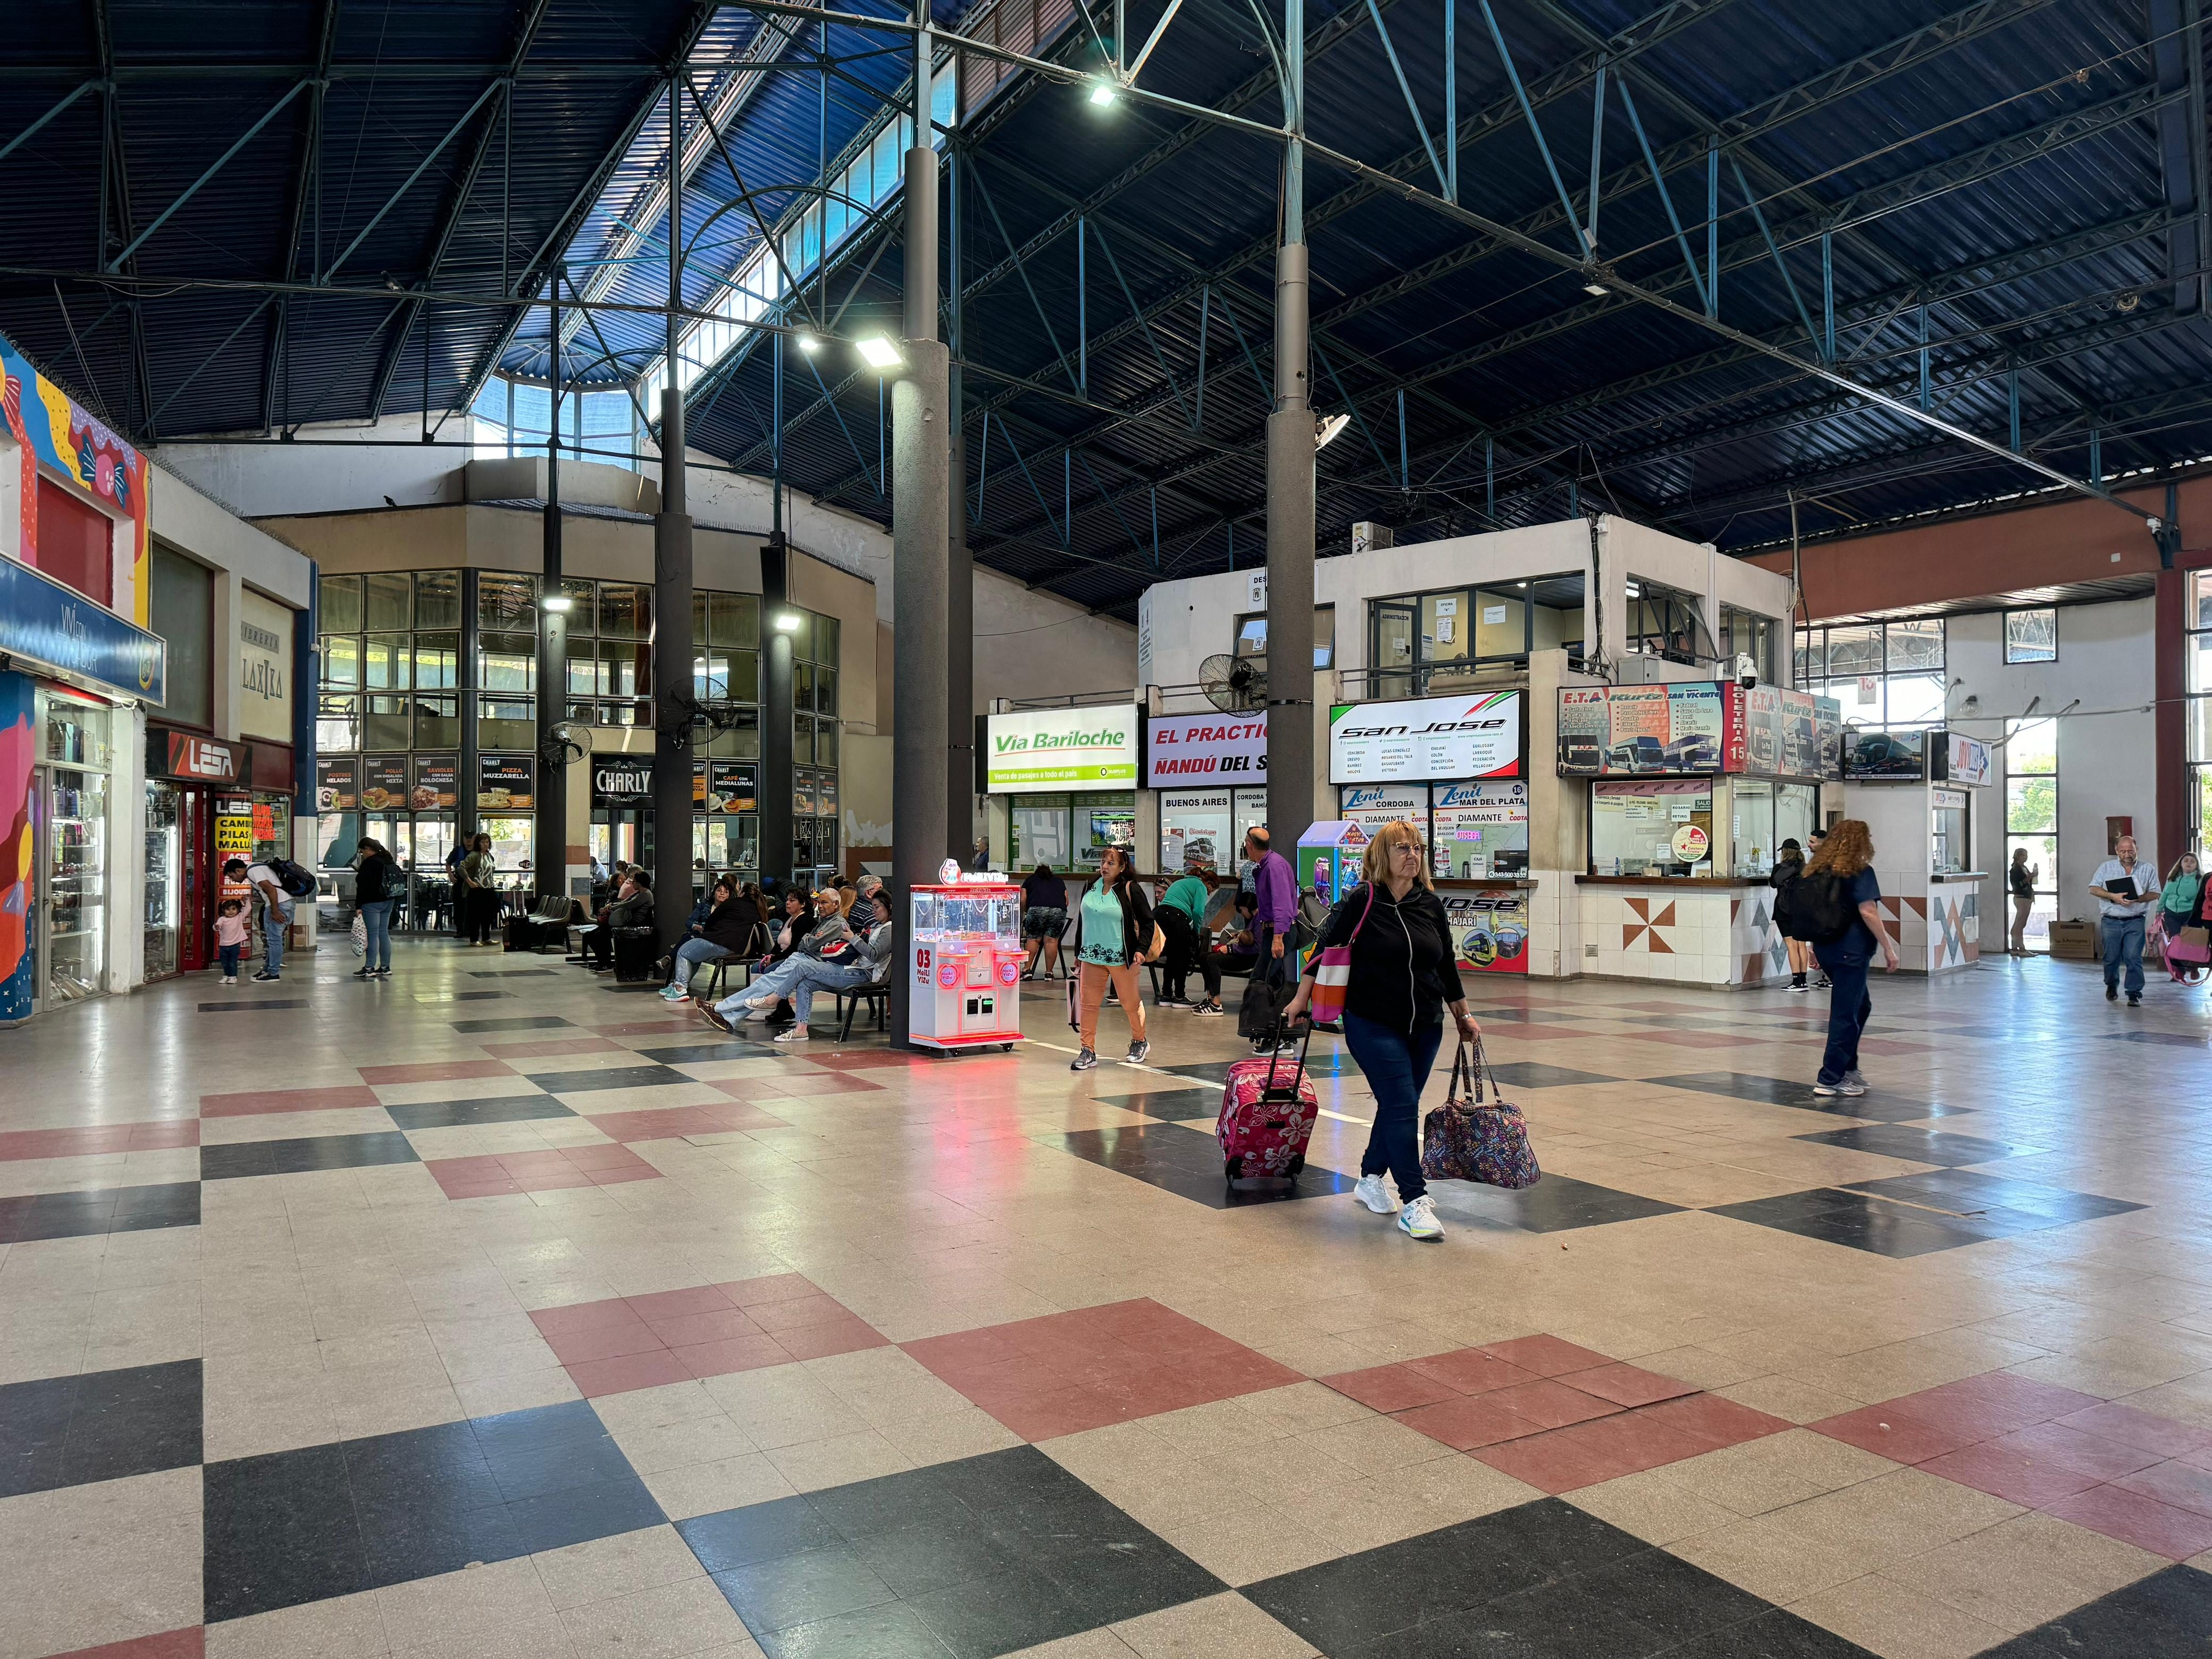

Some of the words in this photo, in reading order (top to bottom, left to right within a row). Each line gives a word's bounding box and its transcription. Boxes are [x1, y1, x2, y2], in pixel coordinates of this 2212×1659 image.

[241, 625, 278, 649] IBRERIA
[1608, 693, 1664, 702] Kurtz
[1732, 686, 1745, 742] BOLETERIA
[995, 734, 1028, 752] Vía
[1033, 728, 1125, 749] Bariloche
[1155, 730, 1178, 744] EL
[1186, 724, 1267, 742] PRACTI
[1731, 747, 1744, 759] 15
[1018, 771, 1039, 781] pasajes
[1065, 769, 1077, 778] país
[1154, 755, 1217, 775] ÑANDÚ
[1220, 756, 1250, 772] DEL
[596, 769, 651, 793] CHARLY
[1166, 799, 1200, 807] BUENOS
[1202, 798, 1228, 806] AIRES
[1346, 785, 1384, 808] Zenit
[1440, 783, 1482, 806] Zenit
[1447, 915, 1477, 926] HAJARÍ
[917, 948, 931, 969] 03
[917, 968, 930, 977] MeiLi
[917, 976, 929, 985] YiZu
